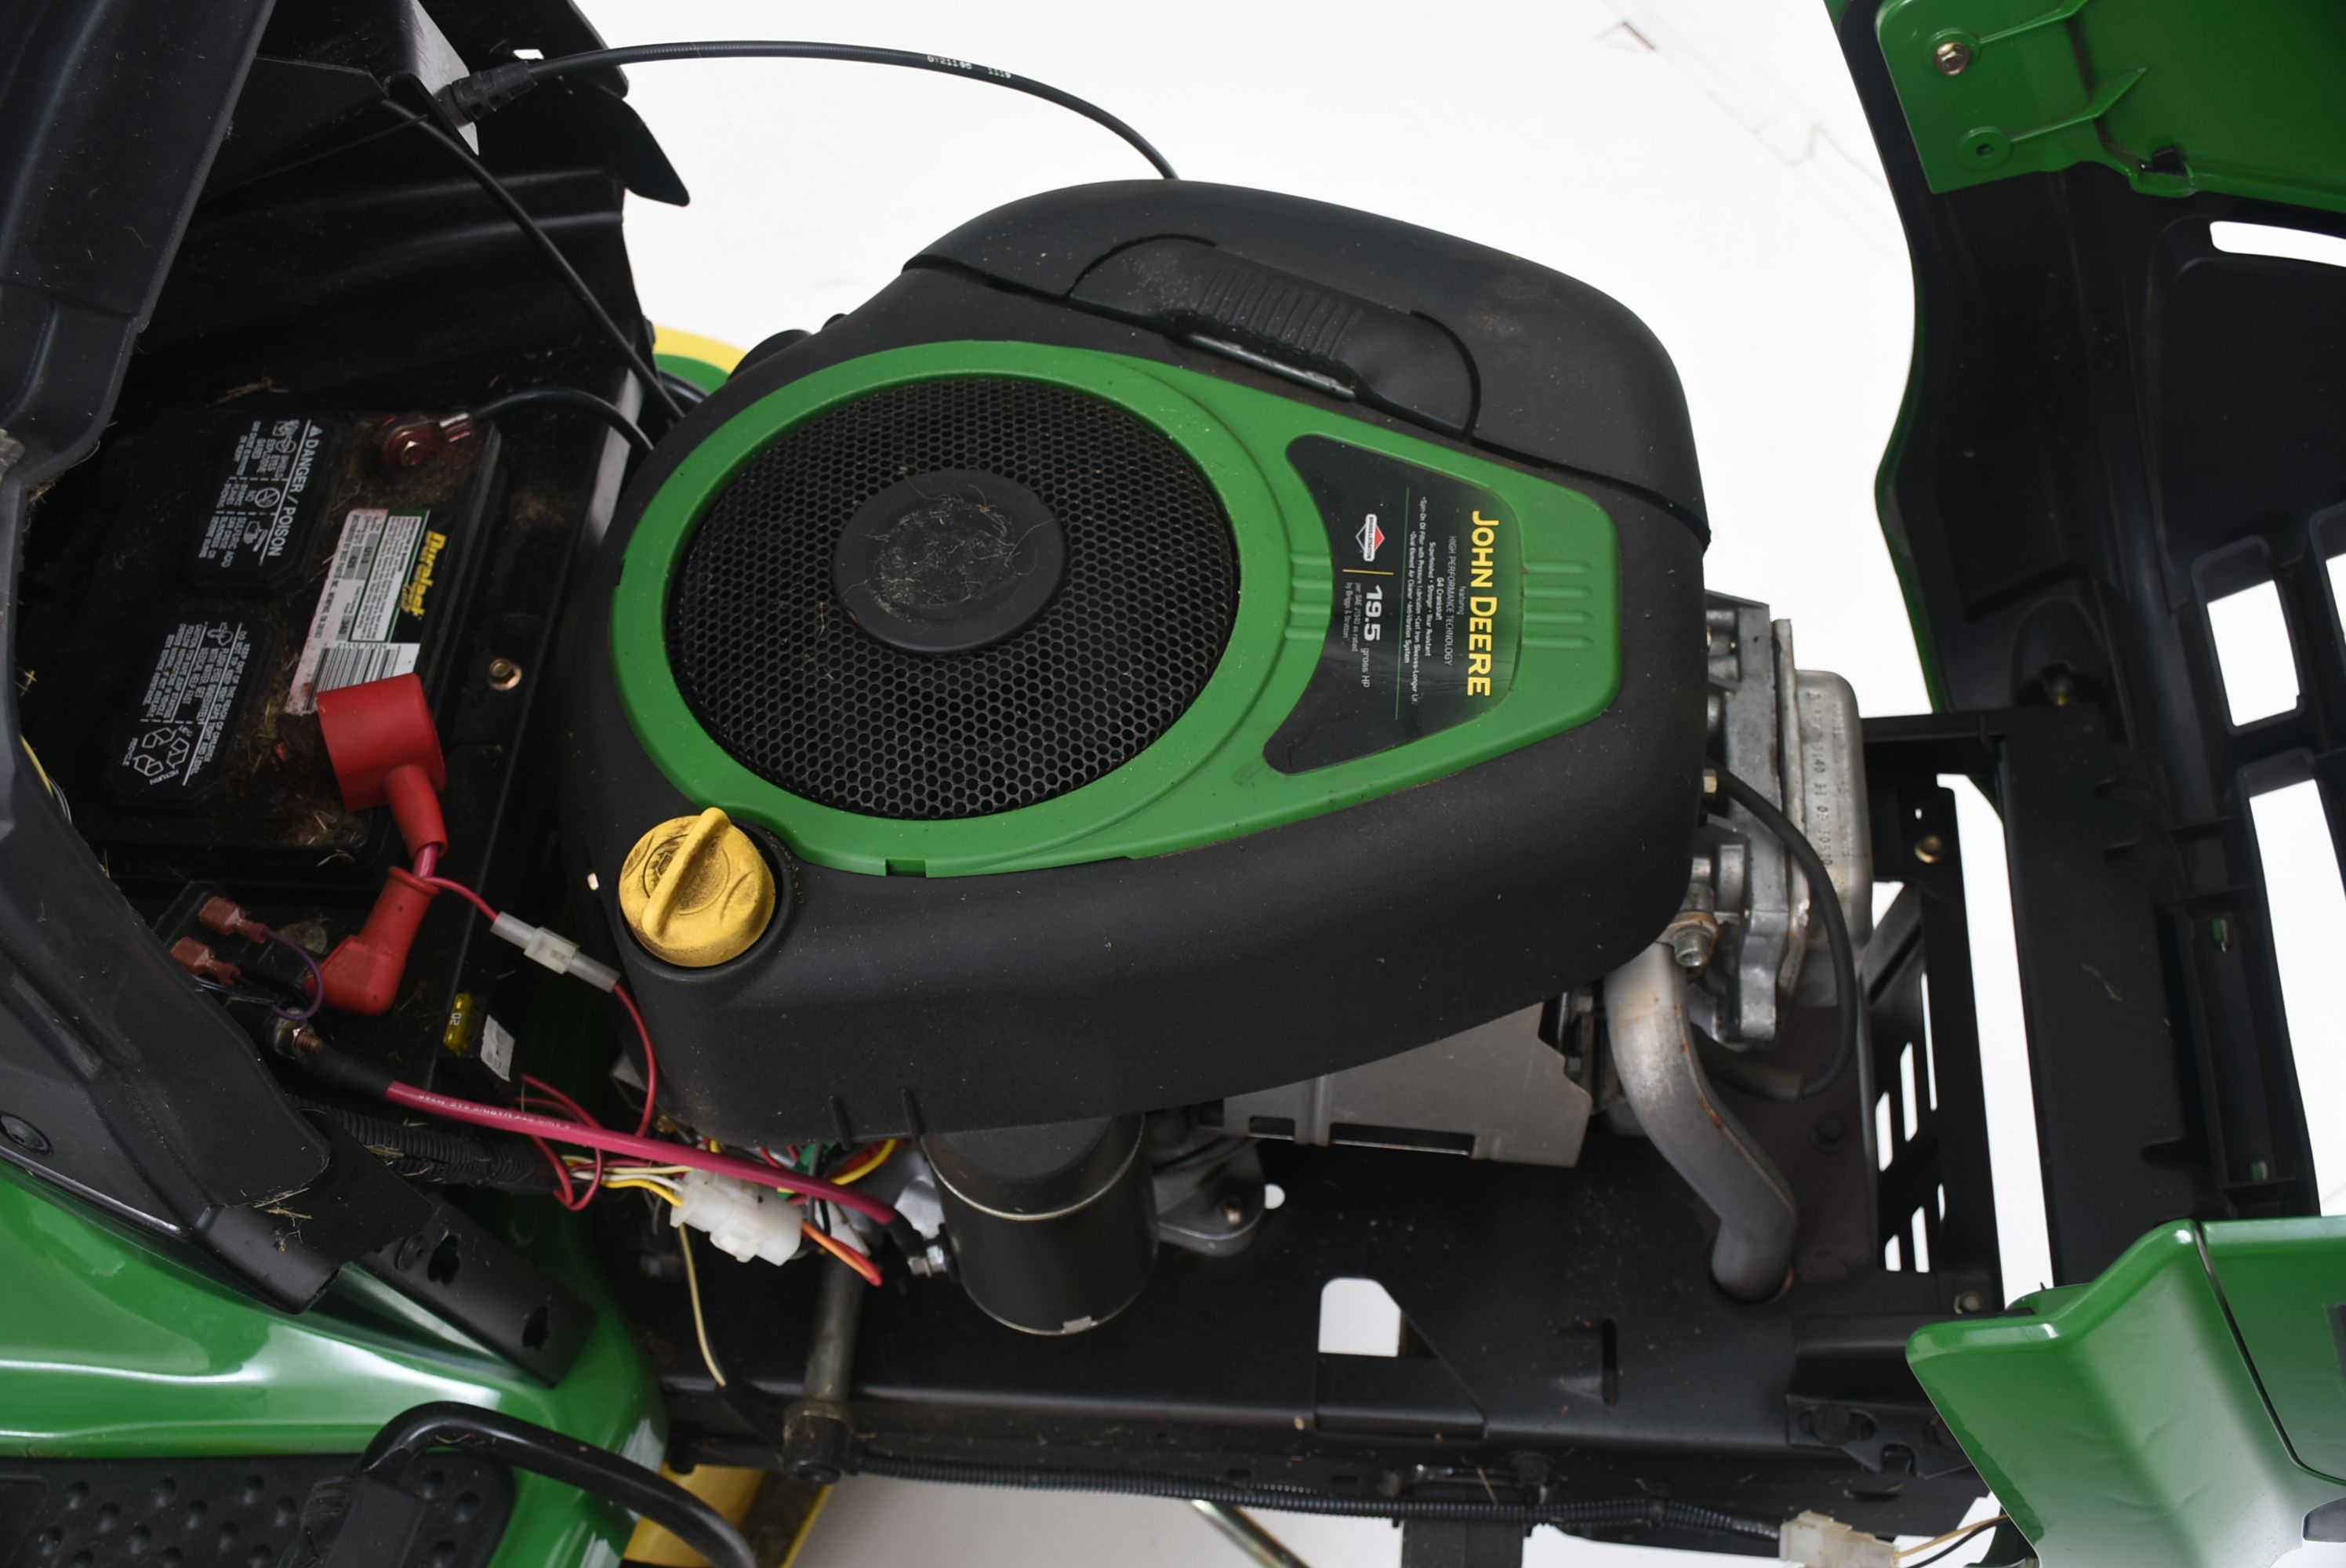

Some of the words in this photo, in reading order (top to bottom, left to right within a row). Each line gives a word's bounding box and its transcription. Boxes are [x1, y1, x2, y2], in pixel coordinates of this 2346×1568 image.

[289, 439, 319, 492] DANGER
[285, 495, 300, 503] /
[267, 506, 296, 556] POISON
[1447, 535, 1457, 554] HIGH
[1470, 510, 1499, 587] JOHN
[412, 531, 447, 616] Duralast
[1436, 577, 1444, 586] G4
[1445, 555, 1456, 613] PERFORMANCE
[1342, 590, 1352, 608] Briggs
[1425, 584, 1433, 608] Stronger
[1435, 588, 1444, 620] Crankshaft
[1456, 586, 1466, 615] featuring
[1363, 584, 1382, 641] 19.5
[1443, 615, 1454, 666] TECHNOLOGY
[1468, 597, 1497, 696] DEERE
[1359, 648, 1371, 672] gross
[1360, 675, 1369, 687] HP
[450, 1013, 461, 1025] 20
